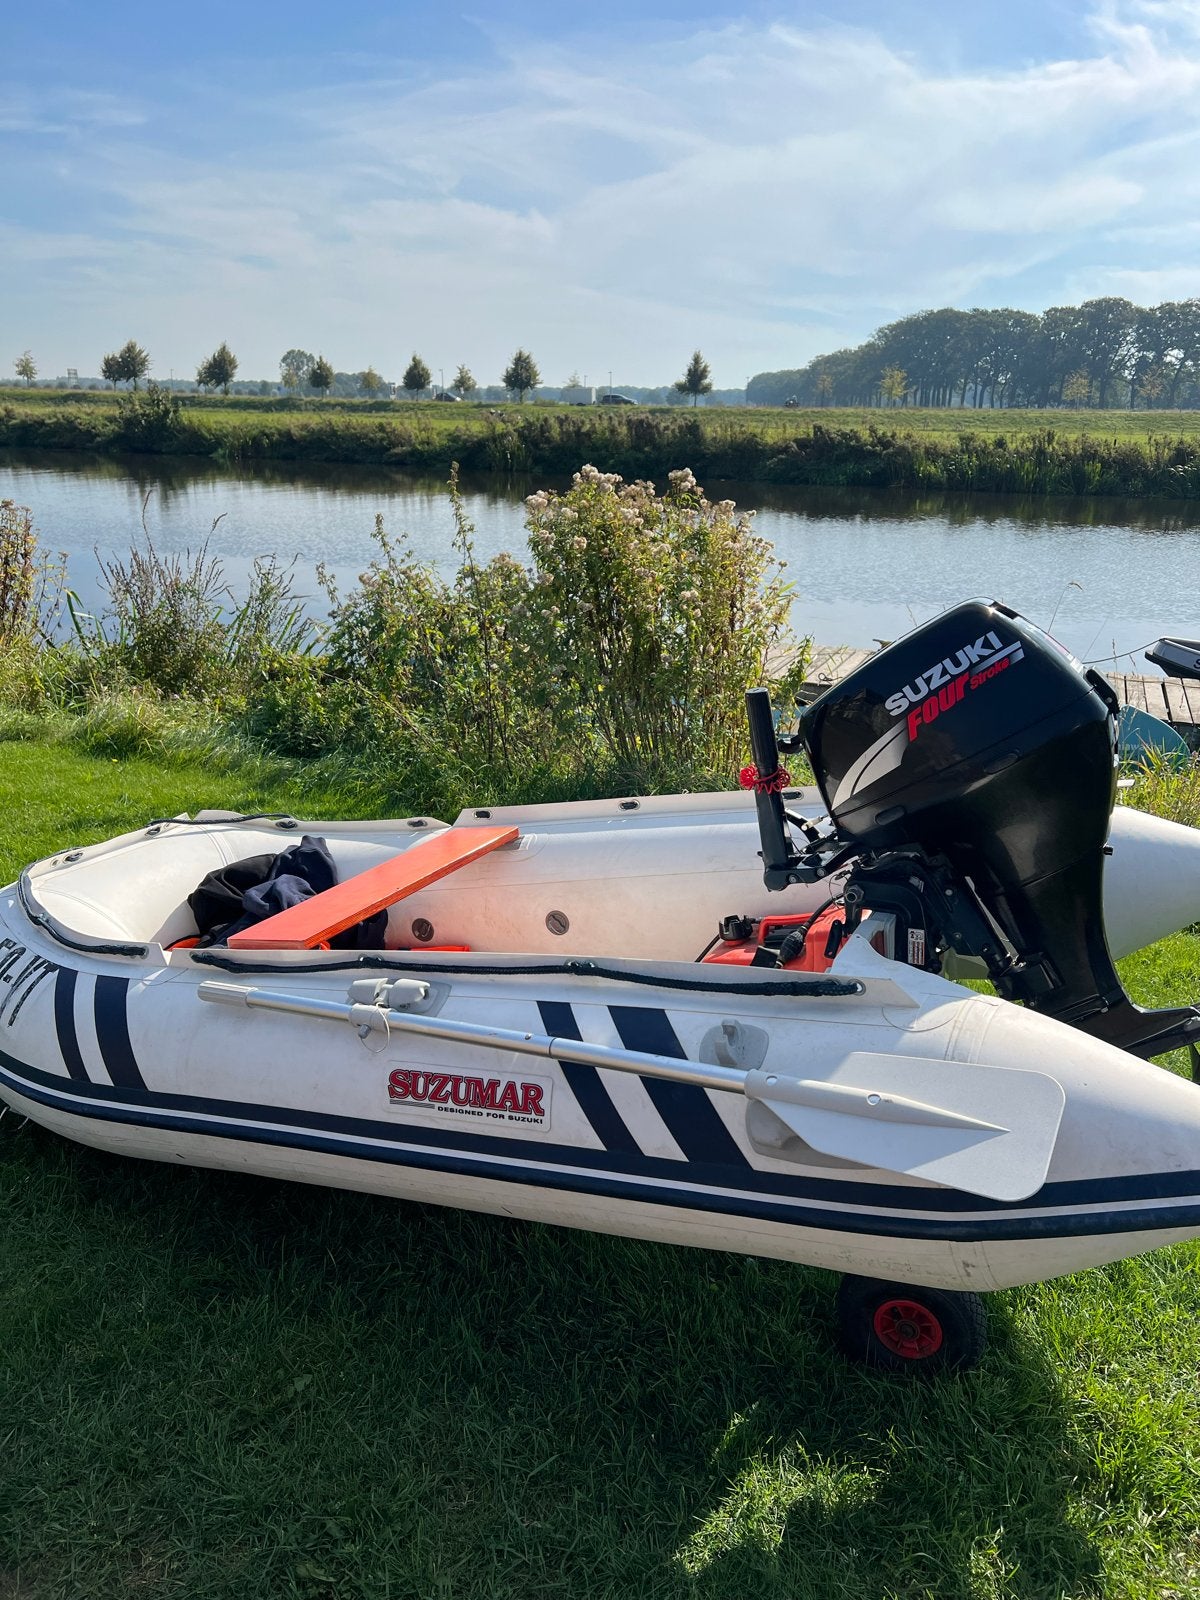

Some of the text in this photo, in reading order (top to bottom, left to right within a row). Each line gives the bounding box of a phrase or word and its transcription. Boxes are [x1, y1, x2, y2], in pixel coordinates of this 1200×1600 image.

[884, 630, 1003, 717] SUZUKI
[969, 657, 1011, 690] Stroke
[387, 1068, 545, 1117] SUZUMAR
[437, 1106, 543, 1124] DESIGNED FOR SUZUKI
